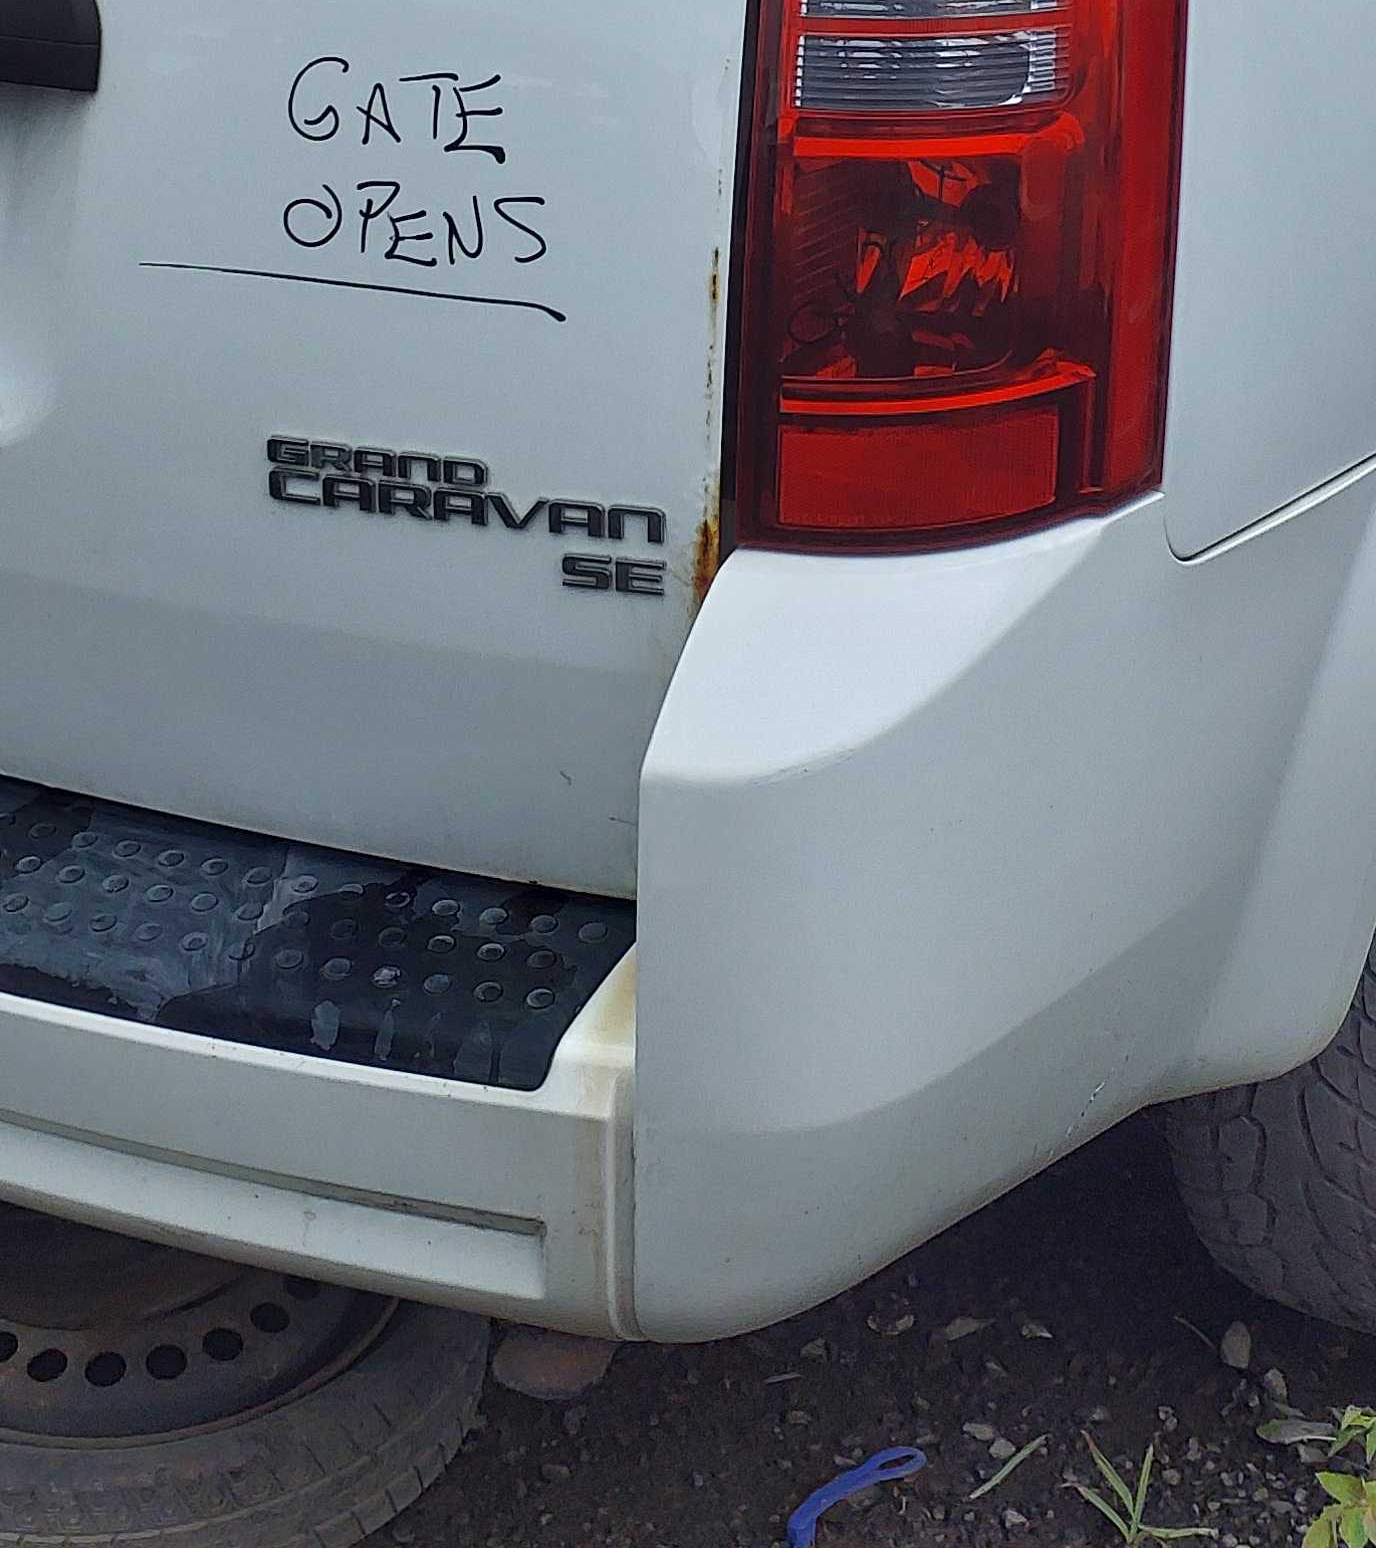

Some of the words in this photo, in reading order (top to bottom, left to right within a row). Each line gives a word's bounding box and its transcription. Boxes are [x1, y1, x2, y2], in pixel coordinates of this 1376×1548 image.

[288, 56, 506, 164] GATE
[283, 182, 547, 267] OPENS
[267, 434, 489, 488] GRAND
[268, 465, 667, 544] CARAVAN
[561, 552, 667, 597] SE
